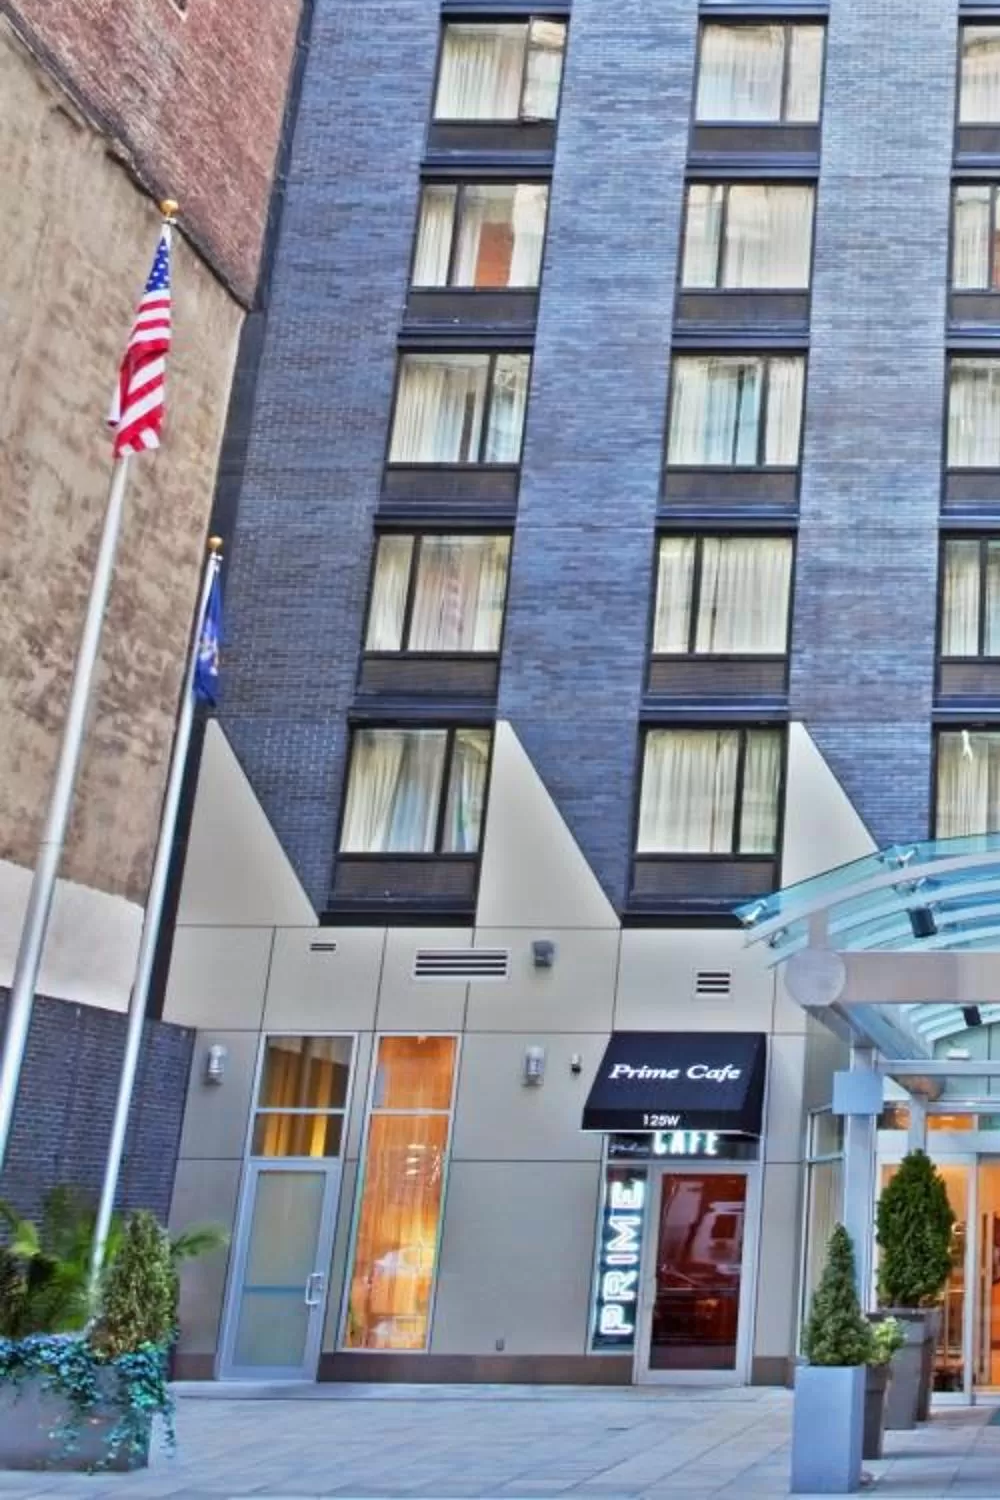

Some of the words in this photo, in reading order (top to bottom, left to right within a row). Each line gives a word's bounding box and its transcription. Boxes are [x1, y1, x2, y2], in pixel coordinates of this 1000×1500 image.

[608, 1063, 680, 1079] Prime
[686, 1063, 741, 1082] Cafe
[642, 1113, 680, 1128] 125W
[653, 1131, 719, 1156] CAFE
[600, 1179, 646, 1336] PRIME
